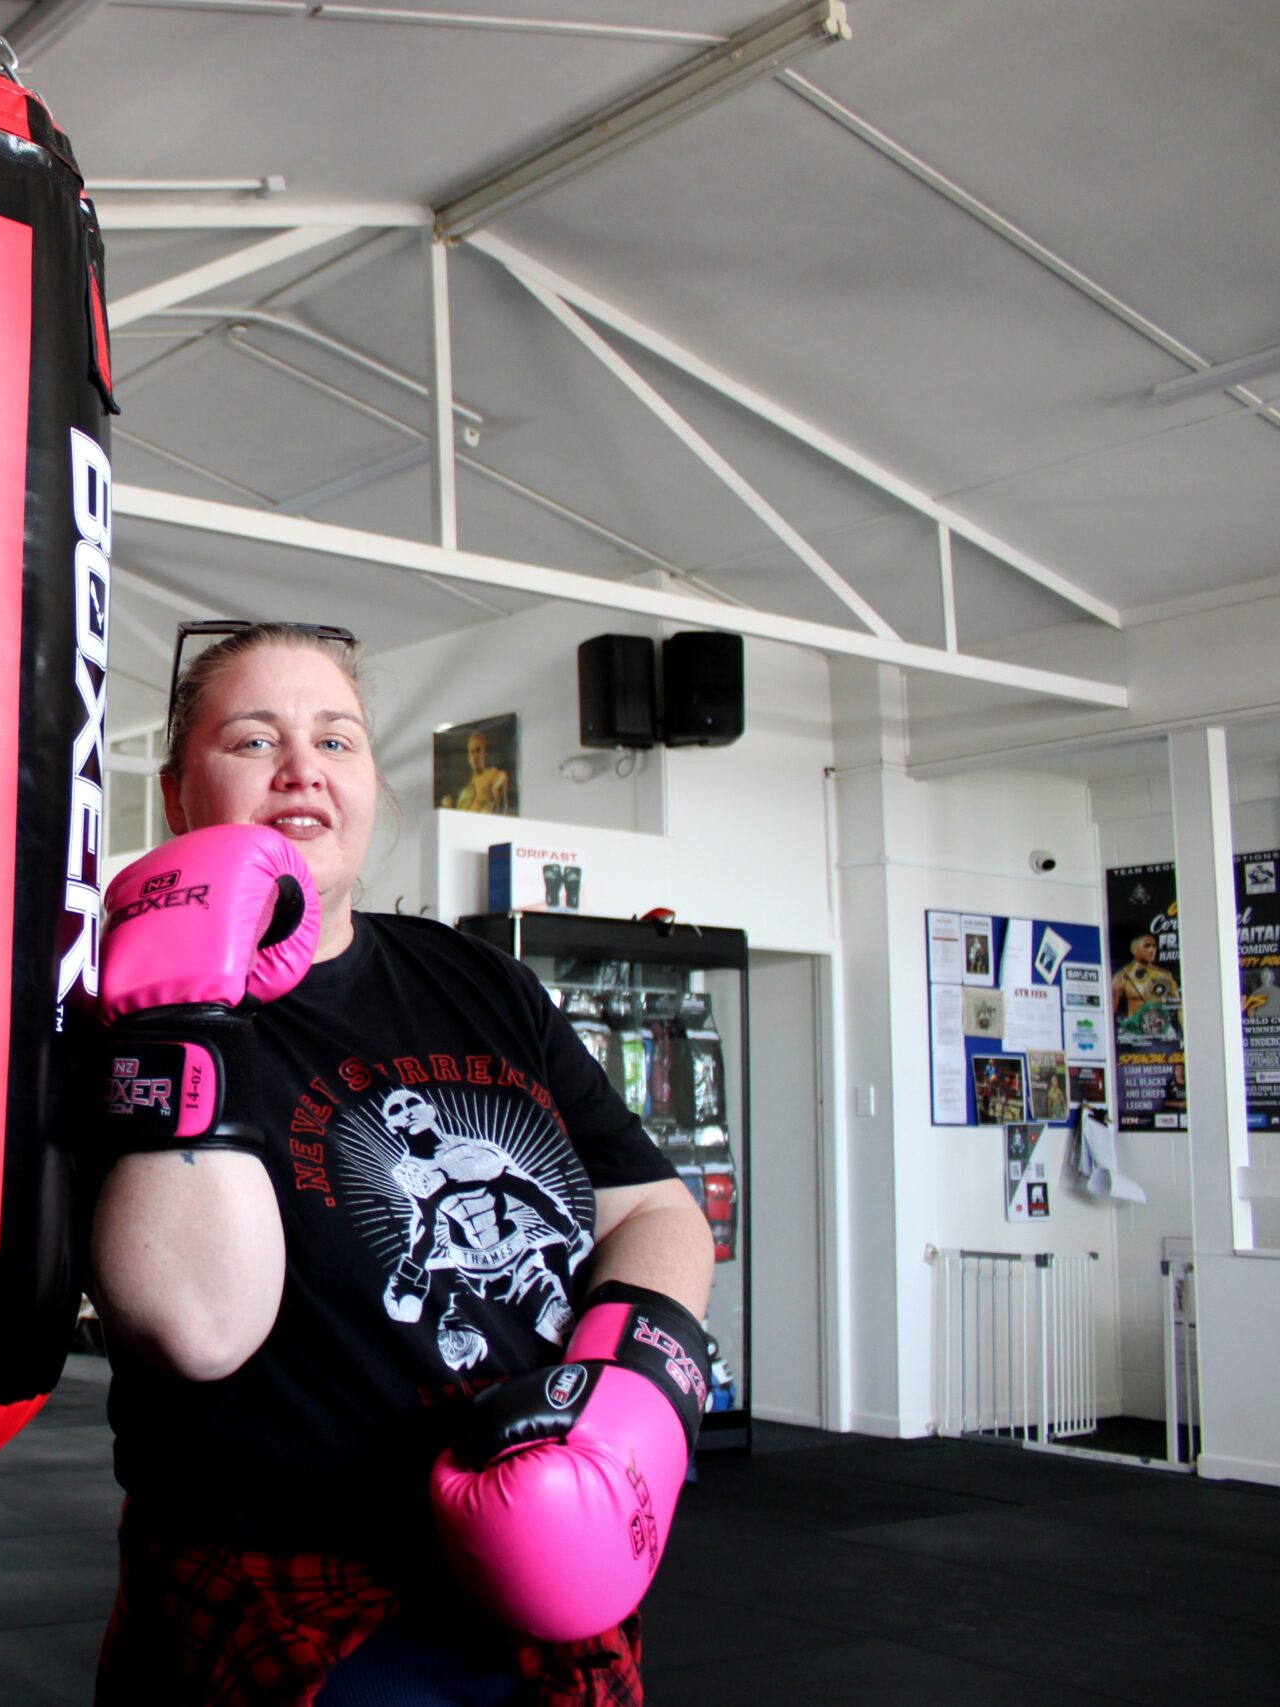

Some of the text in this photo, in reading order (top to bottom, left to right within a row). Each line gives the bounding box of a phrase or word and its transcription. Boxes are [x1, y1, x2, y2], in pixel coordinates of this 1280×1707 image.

[58, 427, 112, 1003] BOXER
[515, 847, 578, 862] DRIFAST
[1233, 852, 1280, 863] OTIONS
[1113, 867, 1143, 877] TEAM
[147, 875, 173, 891] NZ
[1150, 914, 1179, 934] Cor
[1158, 933, 1179, 950] FR
[1159, 951, 1181, 961] HAU
[1031, 989, 1048, 999] FEES
[55, 1004, 64, 1032] TM
[1242, 1017, 1269, 1026] ORLD
[1250, 1037, 1280, 1047] UNDERC
[114, 1062, 134, 1073] NZ
[1125, 1077, 1167, 1087] ALL BLACKS
[1126, 1089, 1140, 1098] AND
[1141, 1089, 1166, 1098] CHIEFS
[1126, 1101, 1153, 1111] LEGEND
[462, 1243, 515, 1266] THAMES
